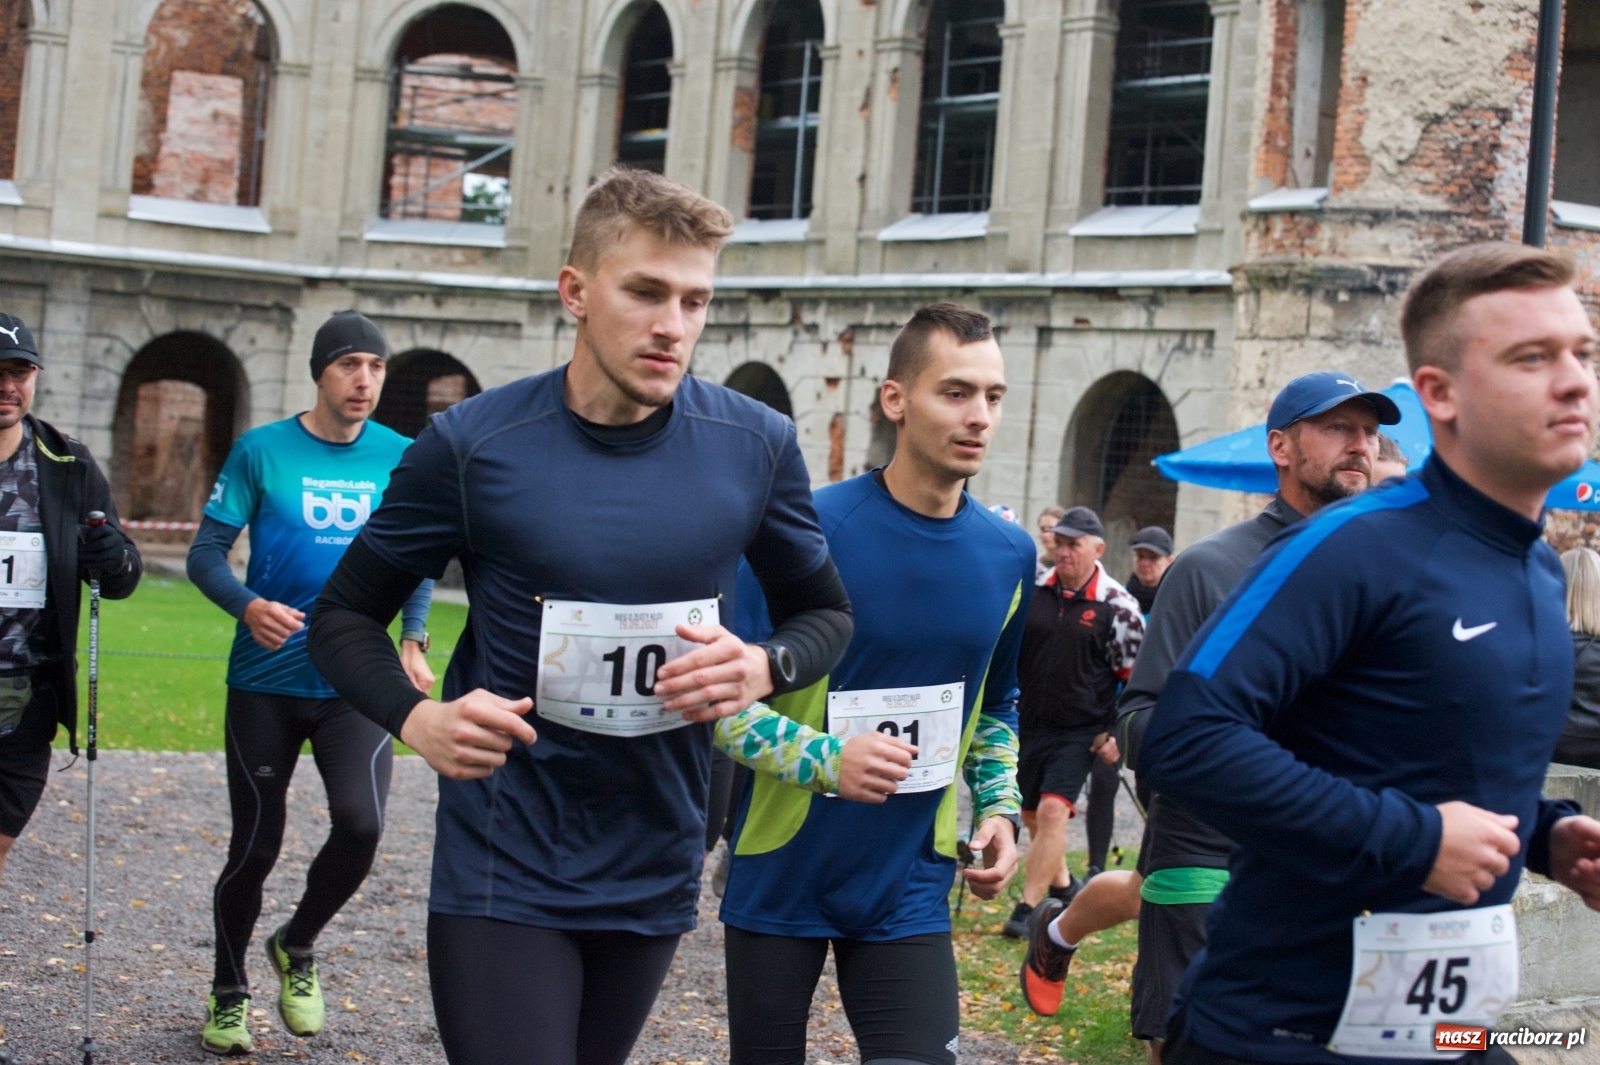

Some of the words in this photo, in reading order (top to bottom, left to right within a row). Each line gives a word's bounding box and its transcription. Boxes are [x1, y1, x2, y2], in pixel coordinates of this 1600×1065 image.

[302, 491, 371, 531] bbl
[603, 644, 666, 696] 10
[1405, 957, 1470, 1014] 45
